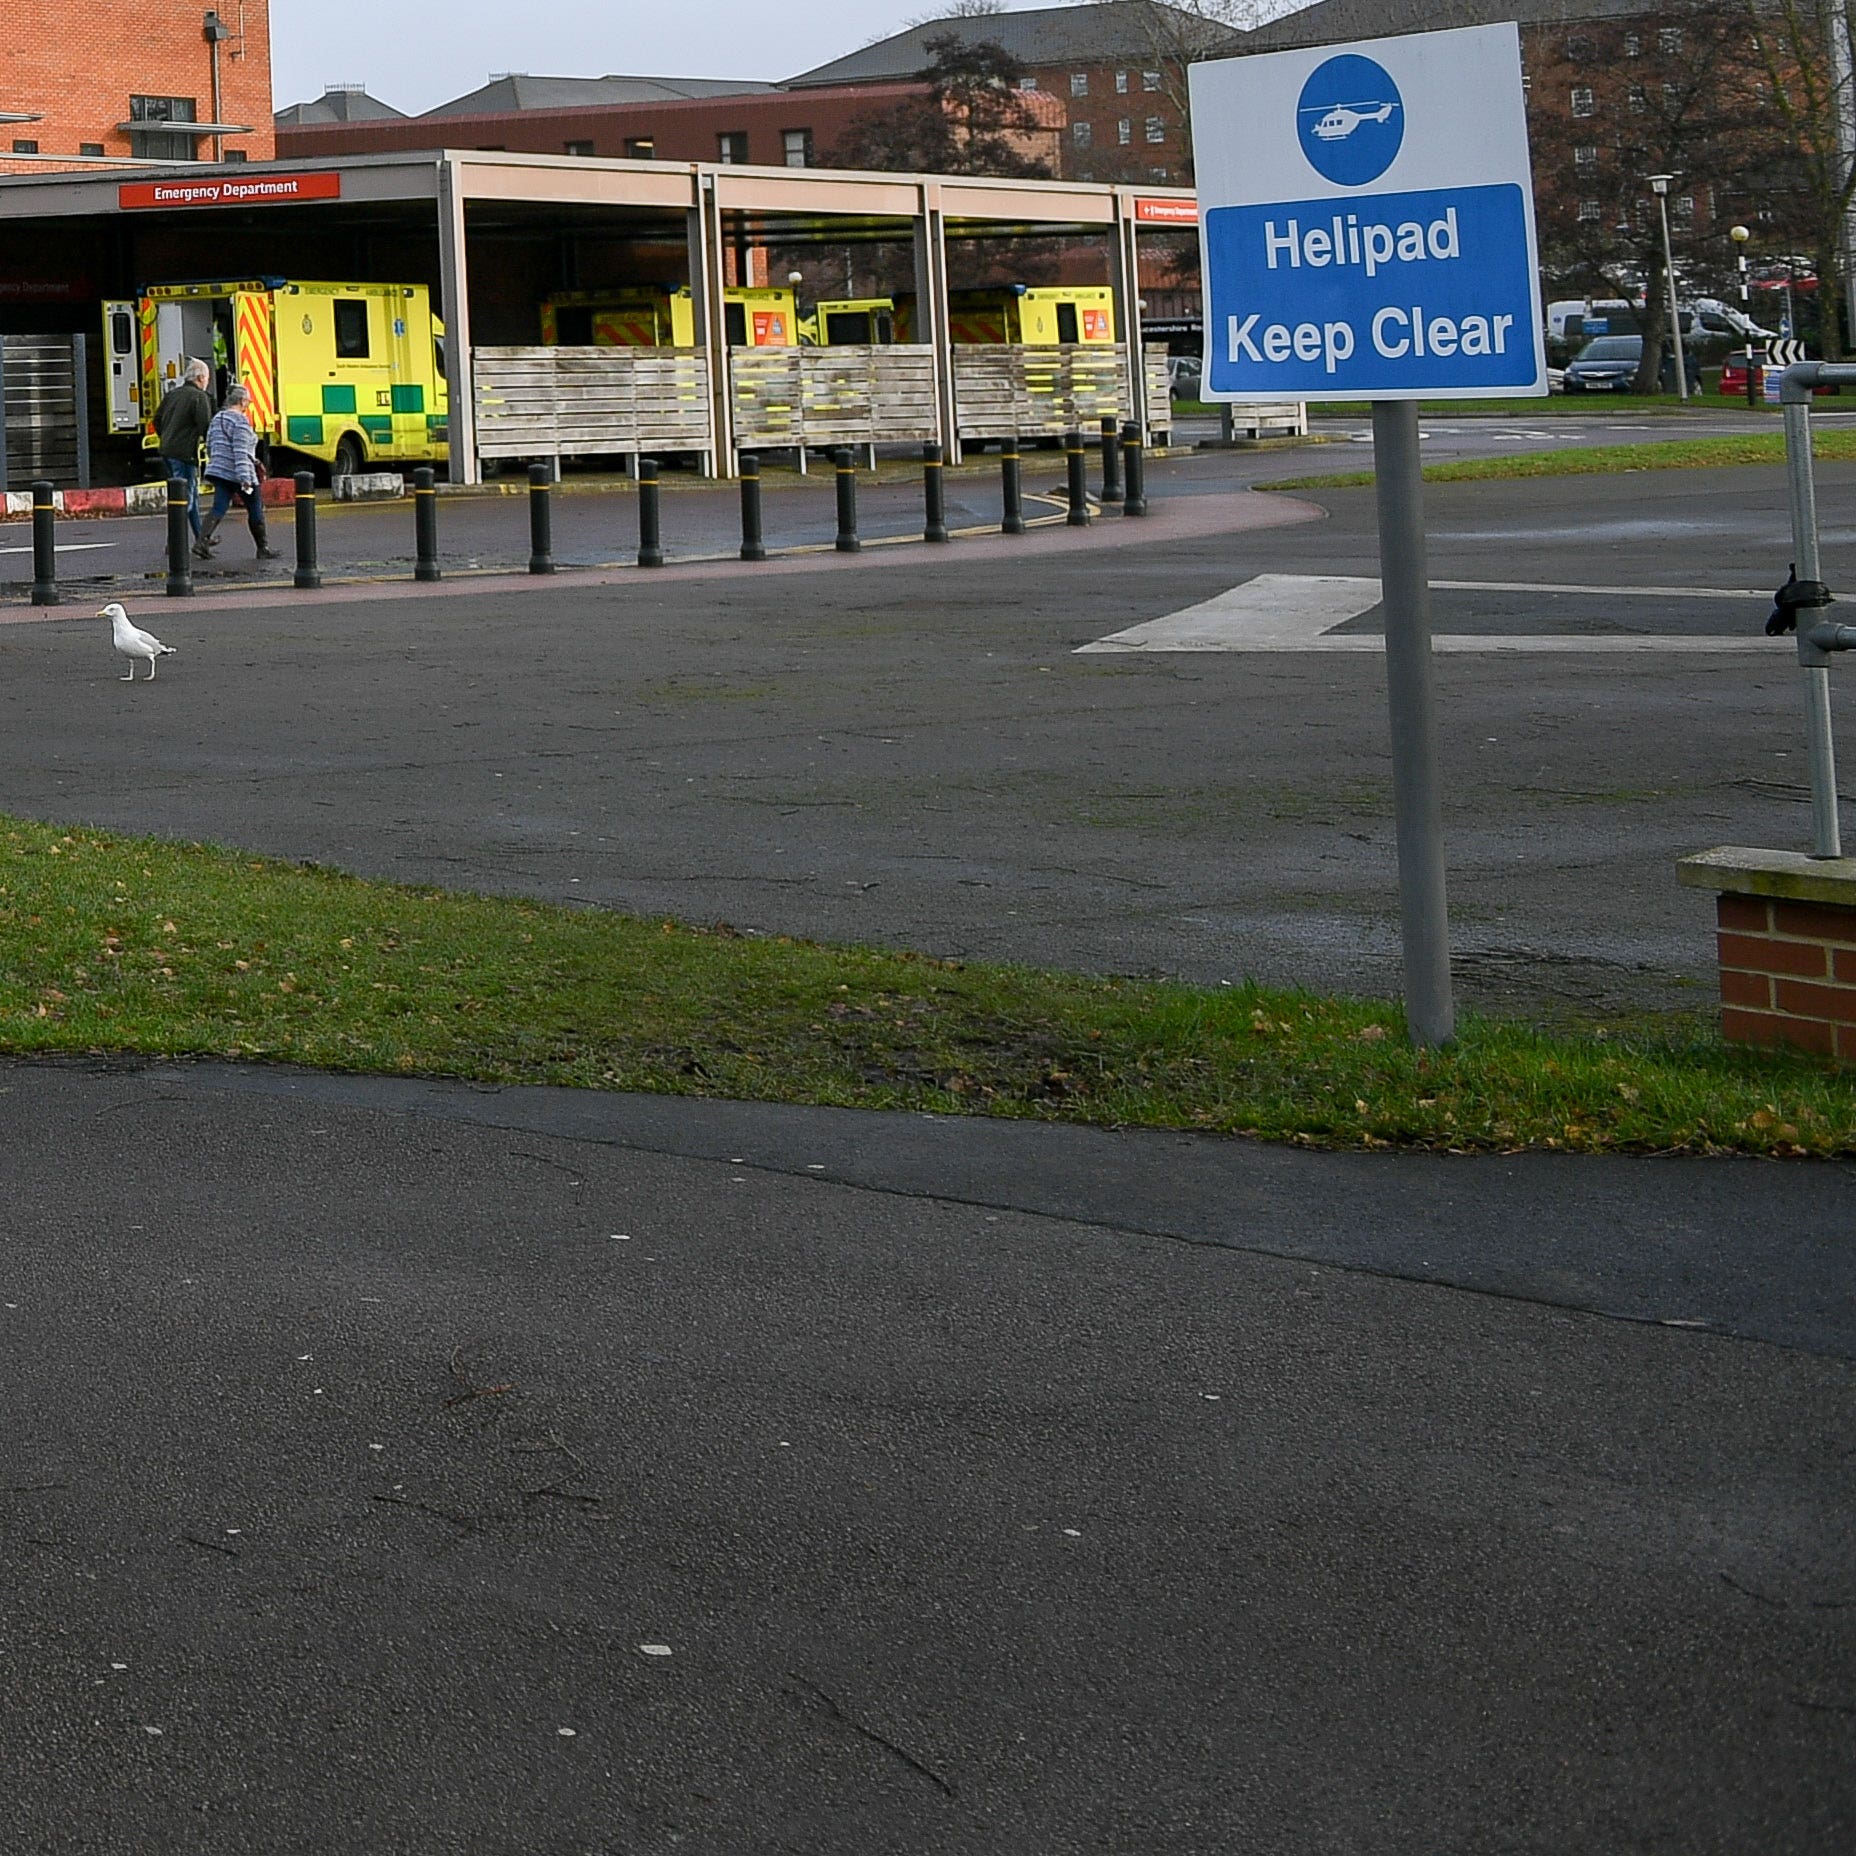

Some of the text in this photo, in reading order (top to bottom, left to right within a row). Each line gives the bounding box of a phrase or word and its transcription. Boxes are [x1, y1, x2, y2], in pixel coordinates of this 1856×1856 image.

[154, 180, 298, 202] Emergency Department
[1264, 206, 1460, 276] Helipad
[22, 281, 69, 295] Department
[1227, 306, 1513, 373] Keep Clear
